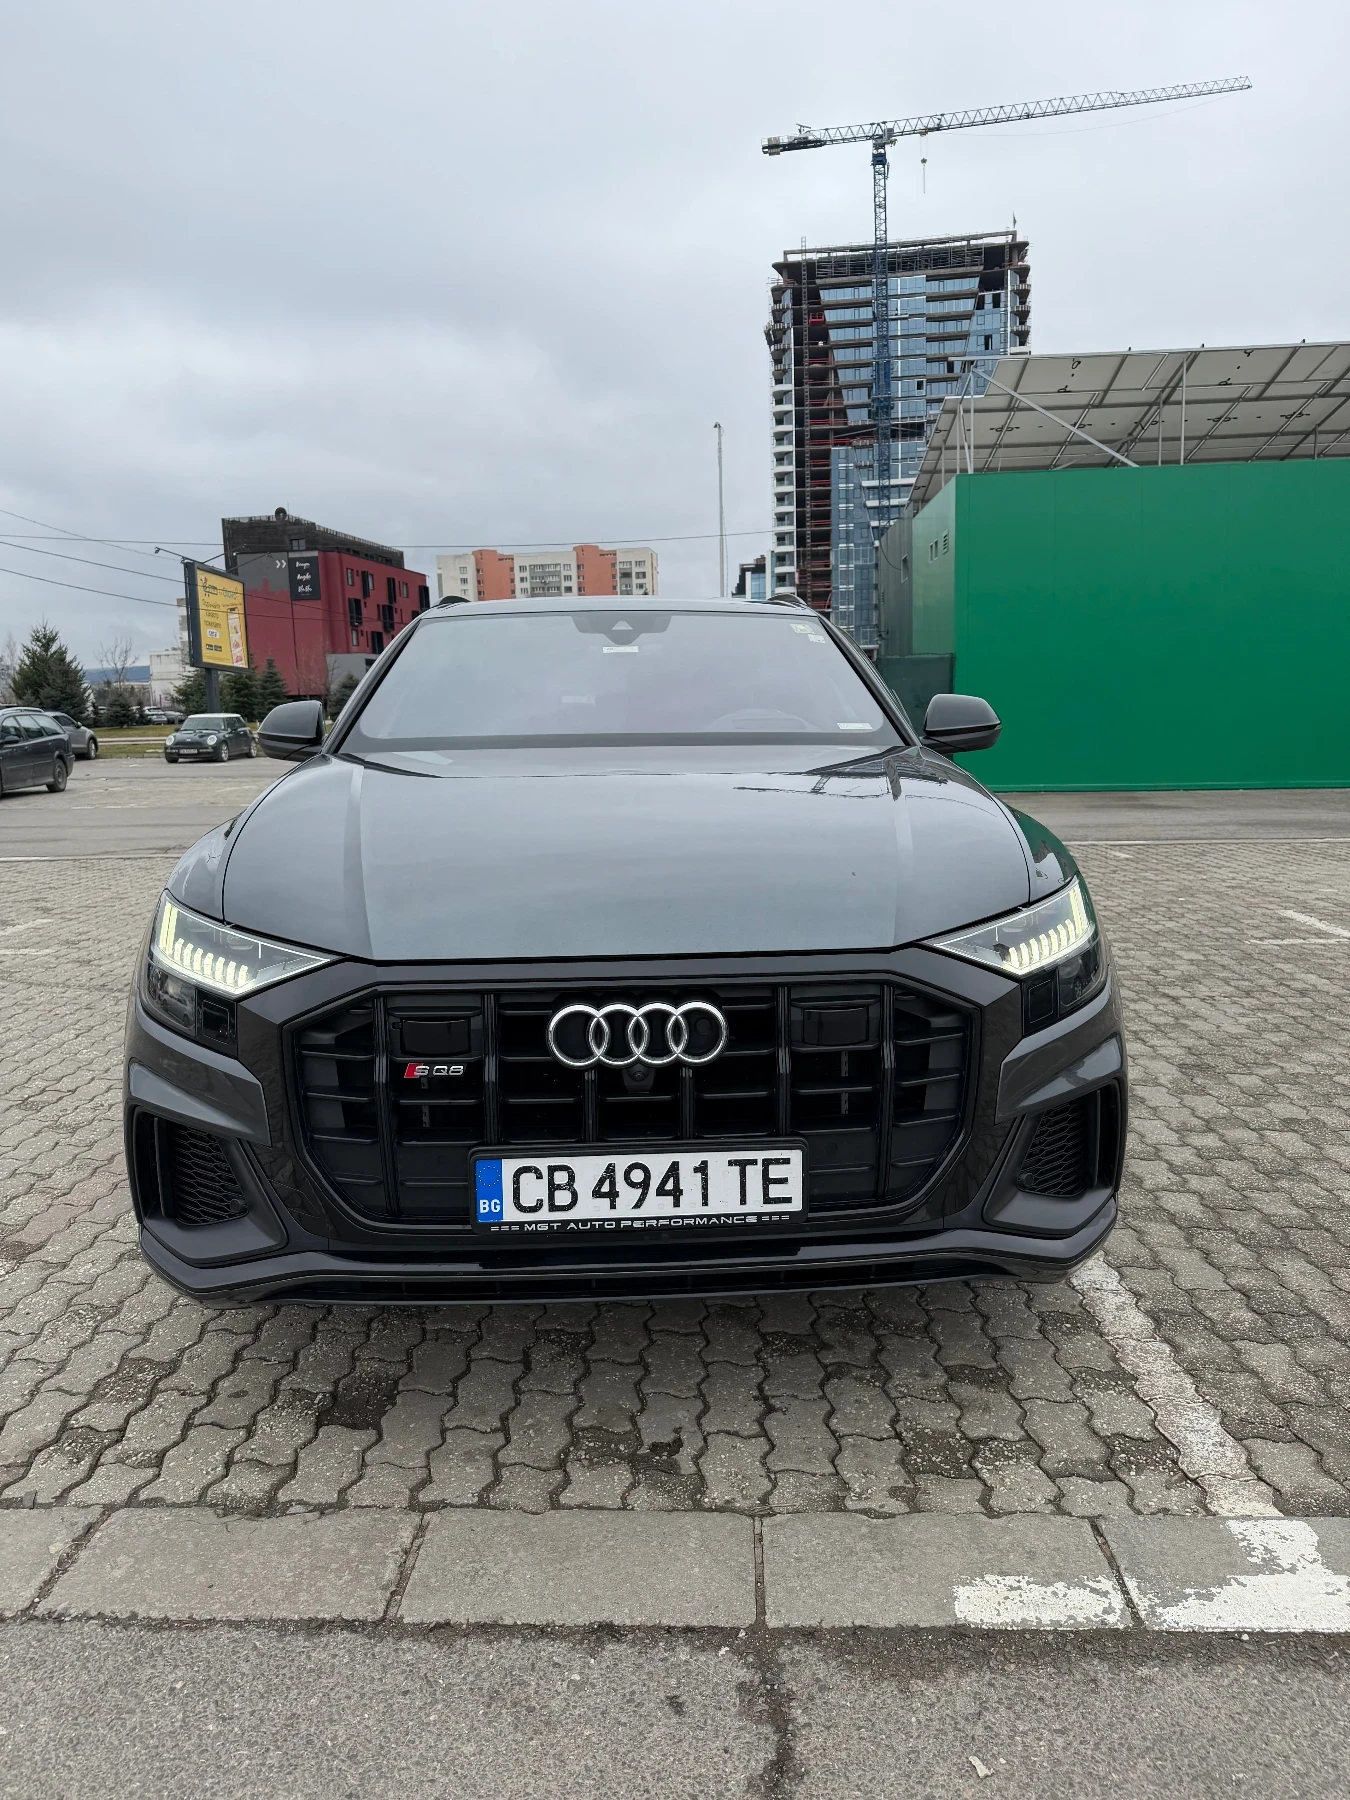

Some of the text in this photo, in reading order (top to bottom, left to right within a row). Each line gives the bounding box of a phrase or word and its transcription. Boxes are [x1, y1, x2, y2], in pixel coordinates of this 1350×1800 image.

[414, 1065, 464, 1076] SQ8
[512, 1157, 793, 1213] CB 4941 TE
[479, 1200, 501, 1213] BG
[524, 1215, 758, 1231] MGT AUTO PERFORMANCE
